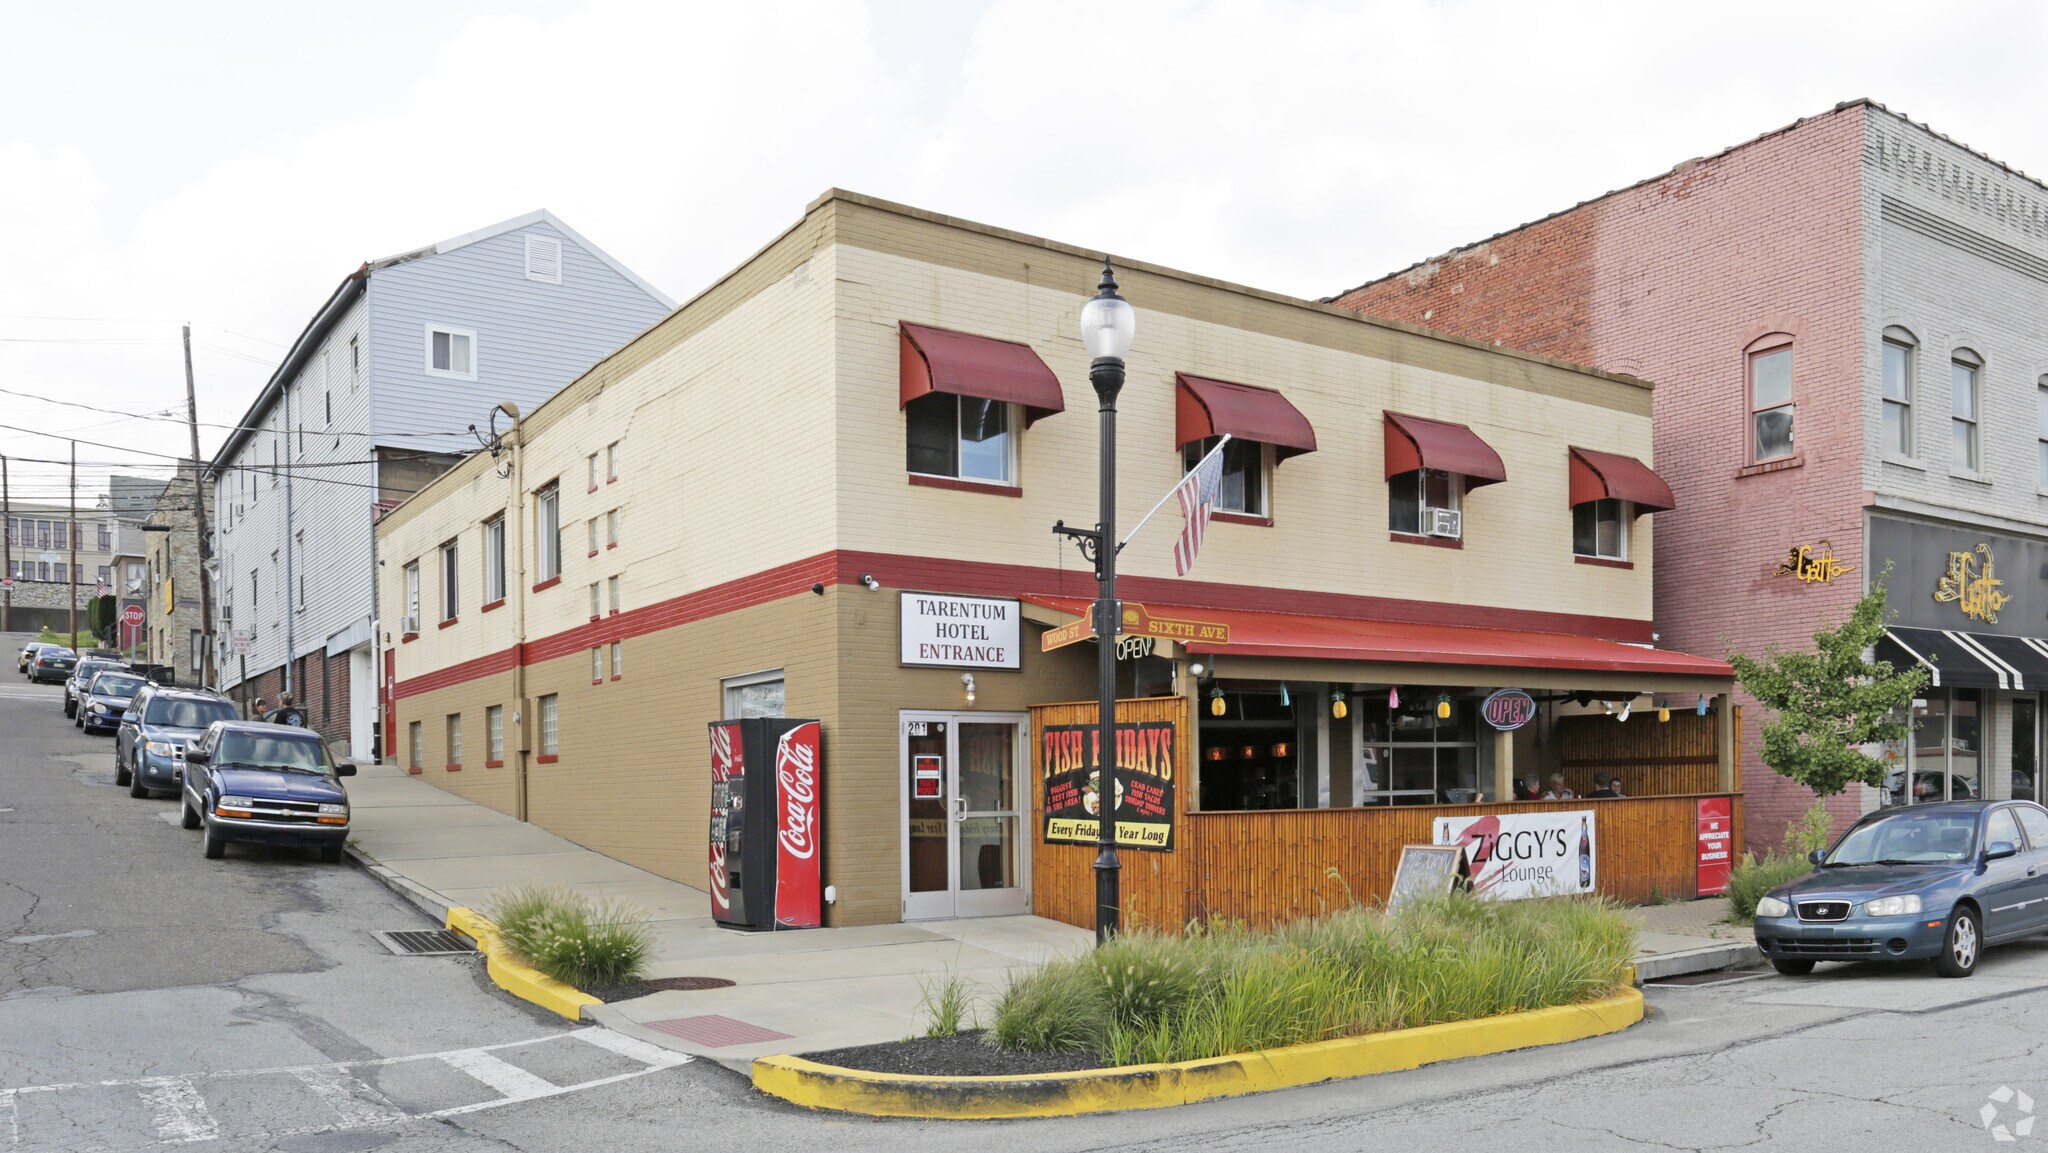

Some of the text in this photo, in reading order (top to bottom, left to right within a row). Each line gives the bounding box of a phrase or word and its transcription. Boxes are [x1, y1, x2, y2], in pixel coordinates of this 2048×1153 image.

[1796, 544, 1856, 584] Gatto
[124, 611, 144, 620] STOP
[916, 600, 1006, 620] TARENTUM
[936, 622, 989, 640] HOTEL
[1046, 625, 1080, 646] WOOD ST
[1149, 621, 1195, 637] SIXTH
[919, 643, 1005, 663] ENTRANCE
[1116, 637, 1152, 661] OPEN
[1489, 697, 1530, 722] OPEN
[908, 722, 926, 735] 201
[1045, 728, 1172, 781] FISH FIDAYS
[1050, 781, 1073, 795] BIGGEST
[1052, 792, 1065, 803] BEST
[1065, 788, 1079, 798] FISH
[1130, 780, 1164, 797] CRAB CAKES
[1131, 788, 1161, 805] FISH TACOS
[779, 741, 813, 860] Coca-Cola
[1051, 822, 1073, 837] Every
[1709, 822, 1719, 830] WE
[1119, 826, 1165, 844] Year Long
[1699, 831, 1730, 841] APPRECIATE
[1707, 842, 1722, 850] YOUR
[1701, 851, 1728, 861] BUSINESS!
[1502, 864, 1553, 885] Lounge
